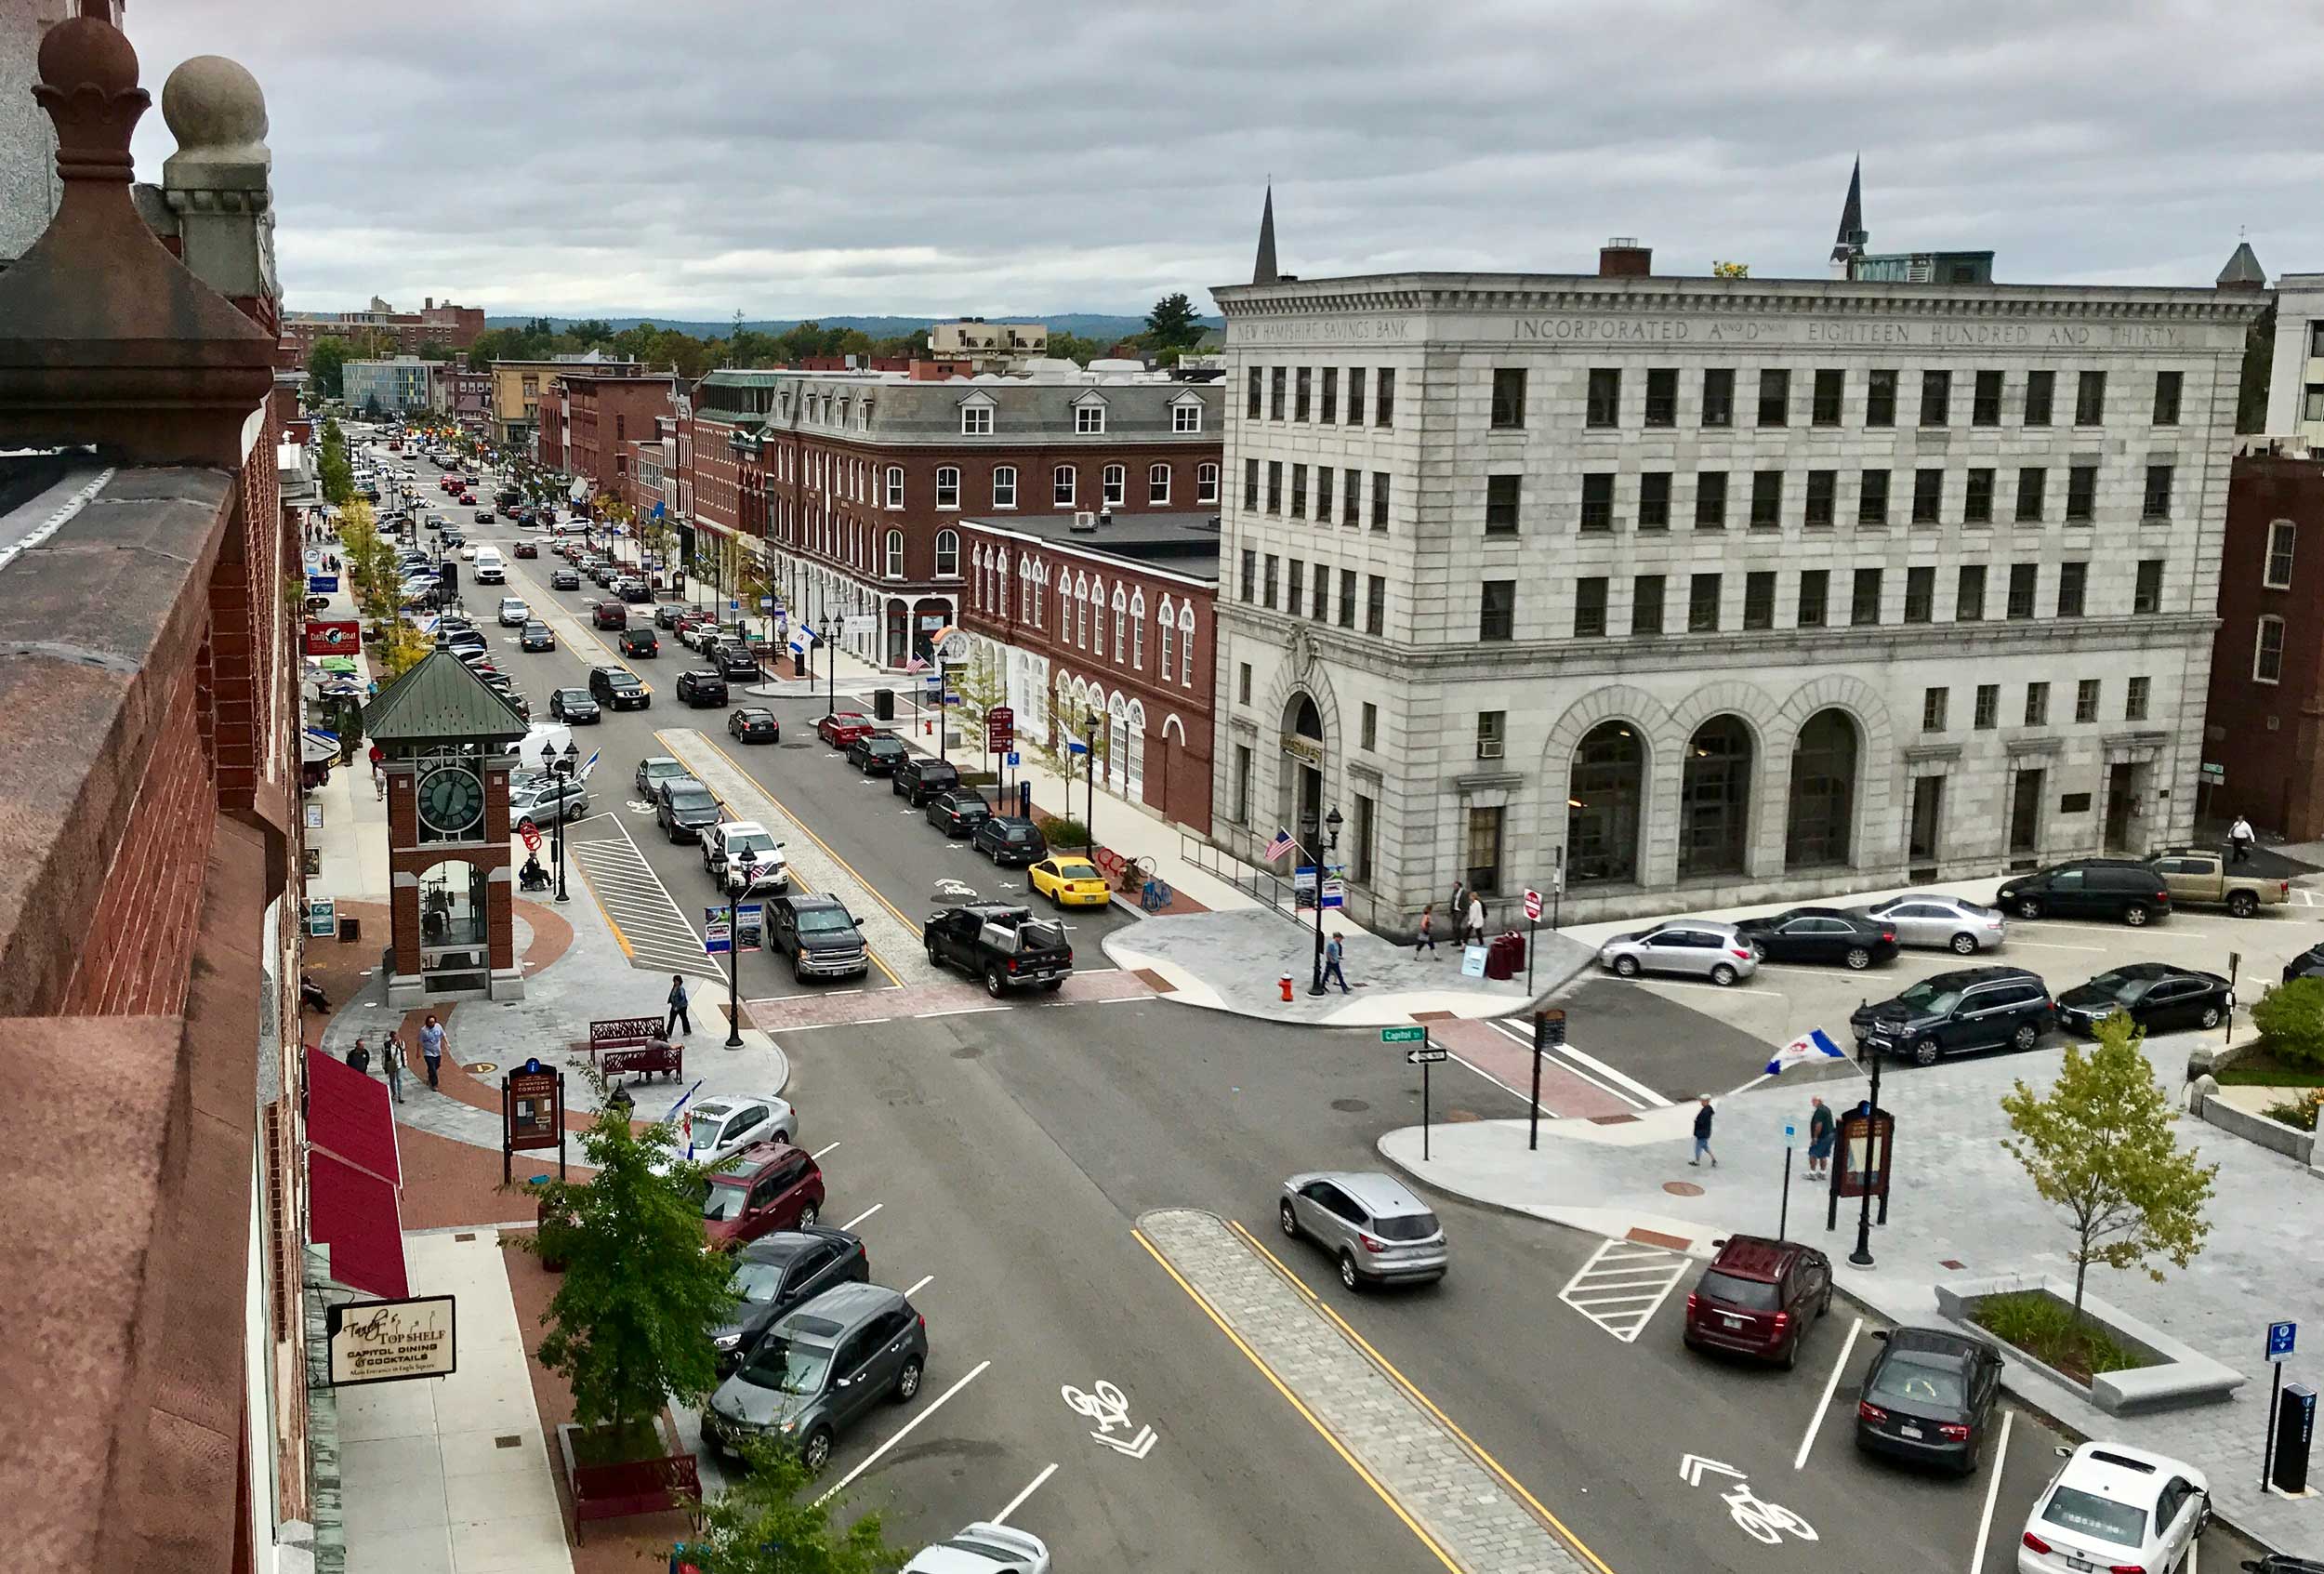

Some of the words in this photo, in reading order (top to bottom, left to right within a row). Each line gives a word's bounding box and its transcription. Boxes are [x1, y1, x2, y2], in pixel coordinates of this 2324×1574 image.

[1237, 324, 1259, 340] NEW
[1263, 323, 1317, 340] HAMPSHIRE
[1324, 321, 1369, 339] SAVINGS
[1376, 319, 1409, 337] BANK
[1513, 319, 1688, 339] INCORPORATED
[1808, 323, 1908, 341] EIGHTEEN
[1932, 324, 2029, 343] HUNDRED
[2048, 326, 2090, 344] AND
[2109, 326, 2177, 345] THIRTY
[379, 1332, 405, 1344] TOP
[406, 1330, 446, 1343] SHELF
[347, 1348, 394, 1358] CAPITOL
[398, 1343, 438, 1354] DINING
[366, 1354, 429, 1366] COCKTAILS
